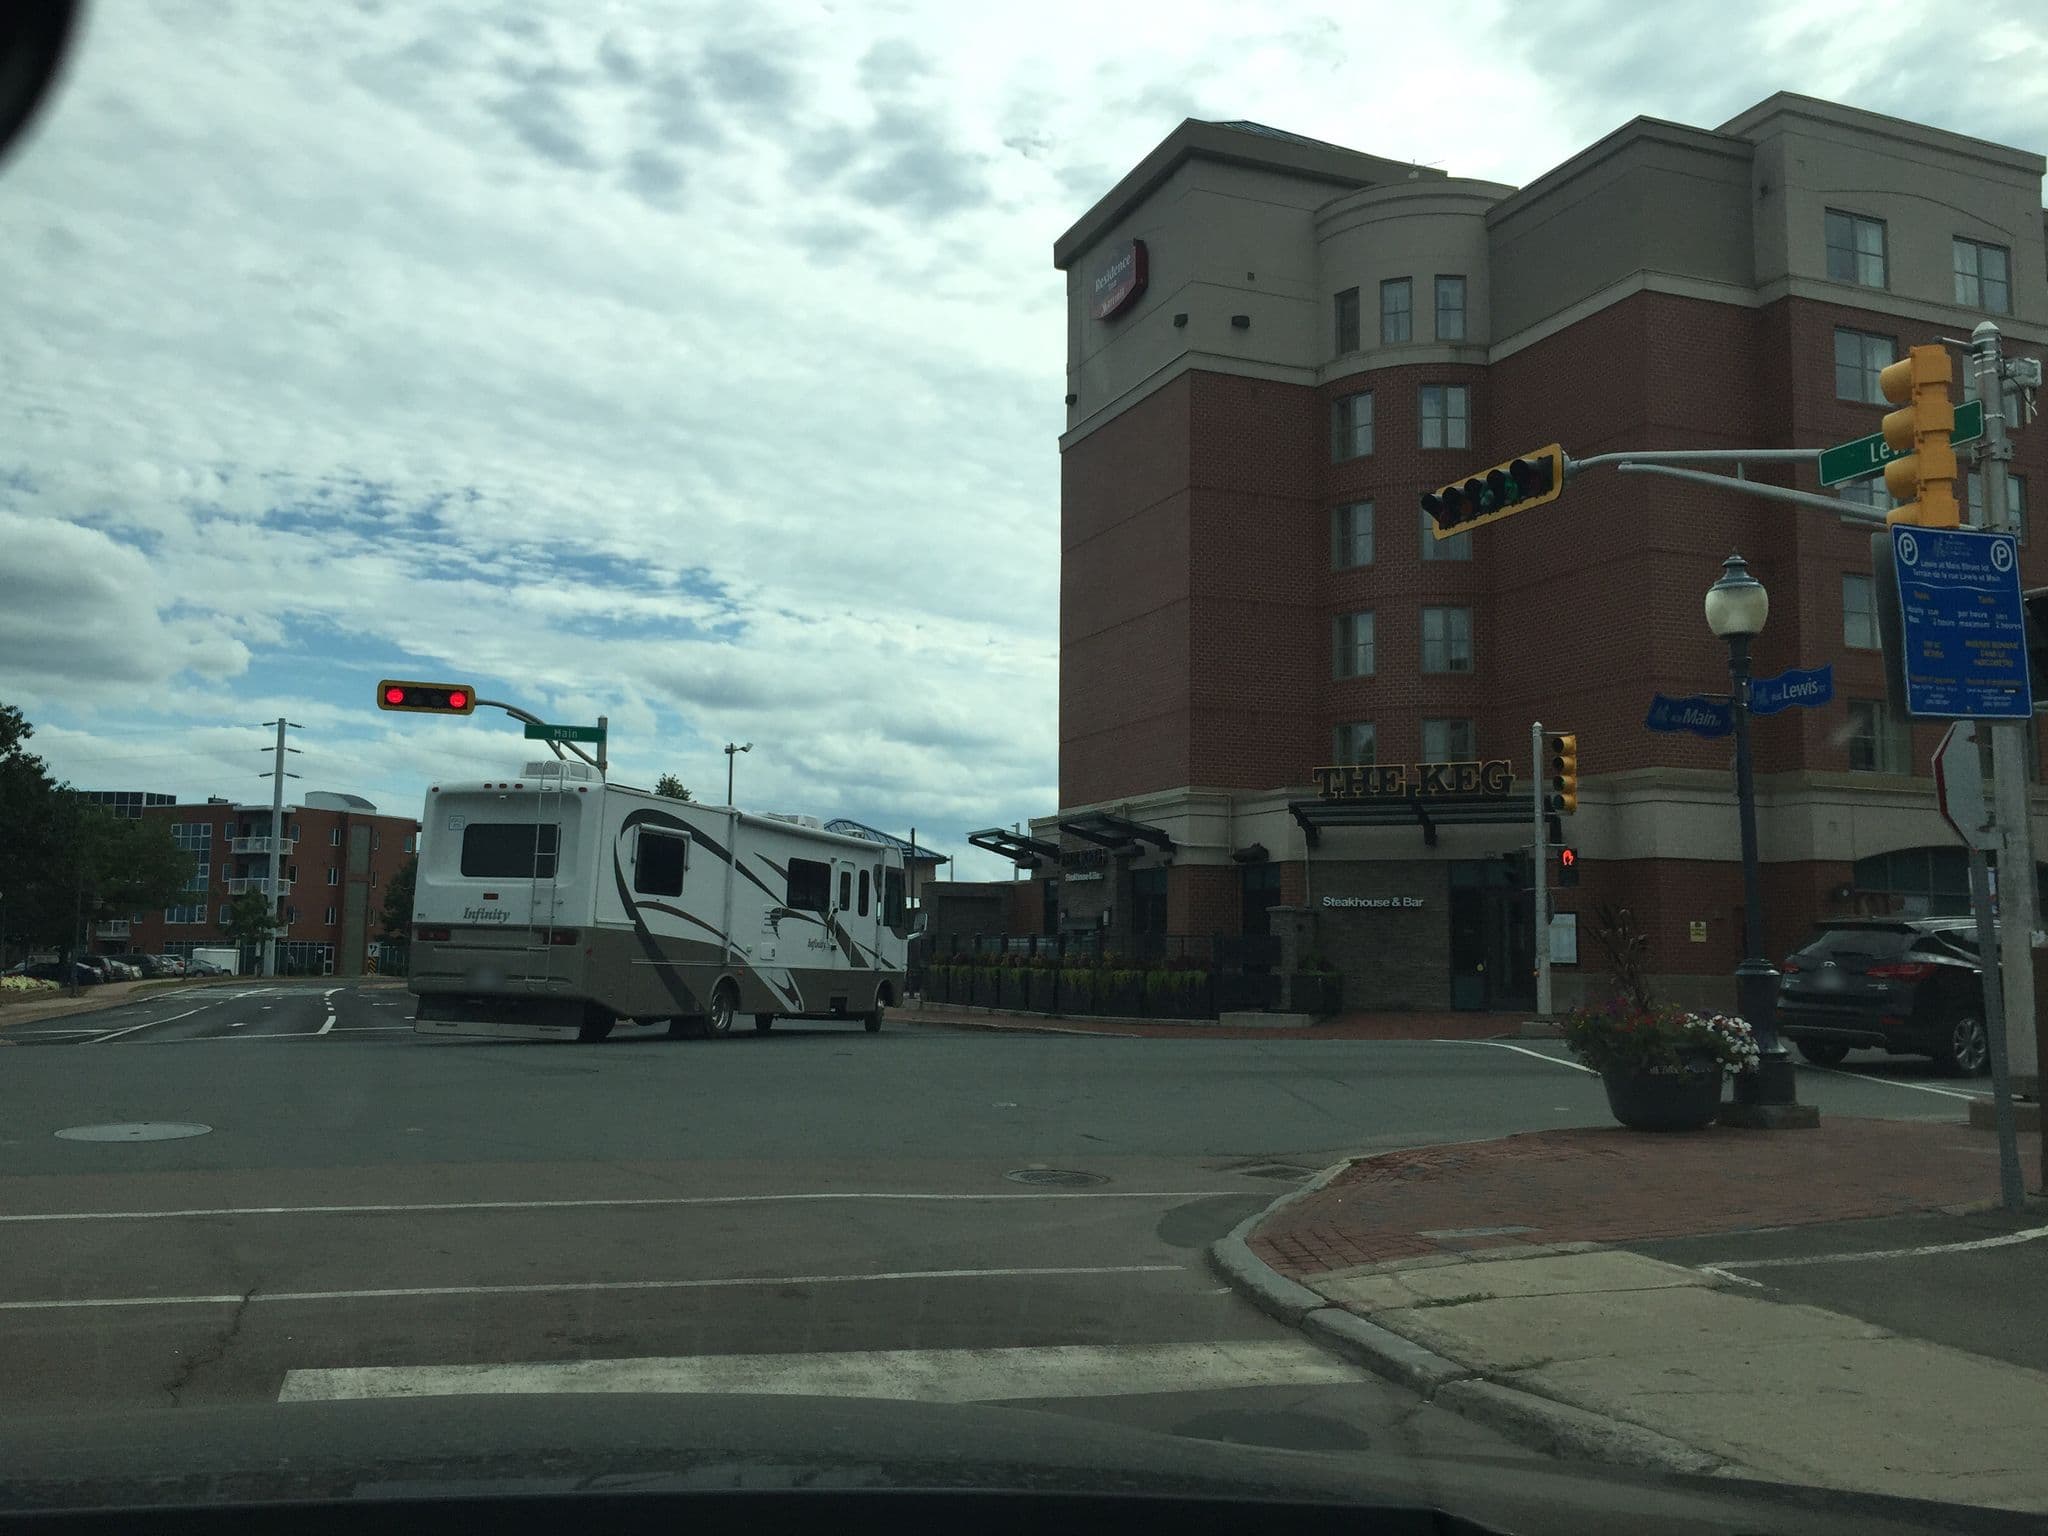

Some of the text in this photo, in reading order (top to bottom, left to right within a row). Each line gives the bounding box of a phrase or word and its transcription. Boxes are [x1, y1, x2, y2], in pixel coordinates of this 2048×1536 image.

[1783, 677, 1818, 700] Lewis
[1683, 709, 1716, 728] Main
[553, 728, 578, 739] Main
[1312, 759, 1517, 800] THE KEG
[1322, 896, 1424, 908] Steakhouse & Bar
[463, 906, 511, 923] Infinity
